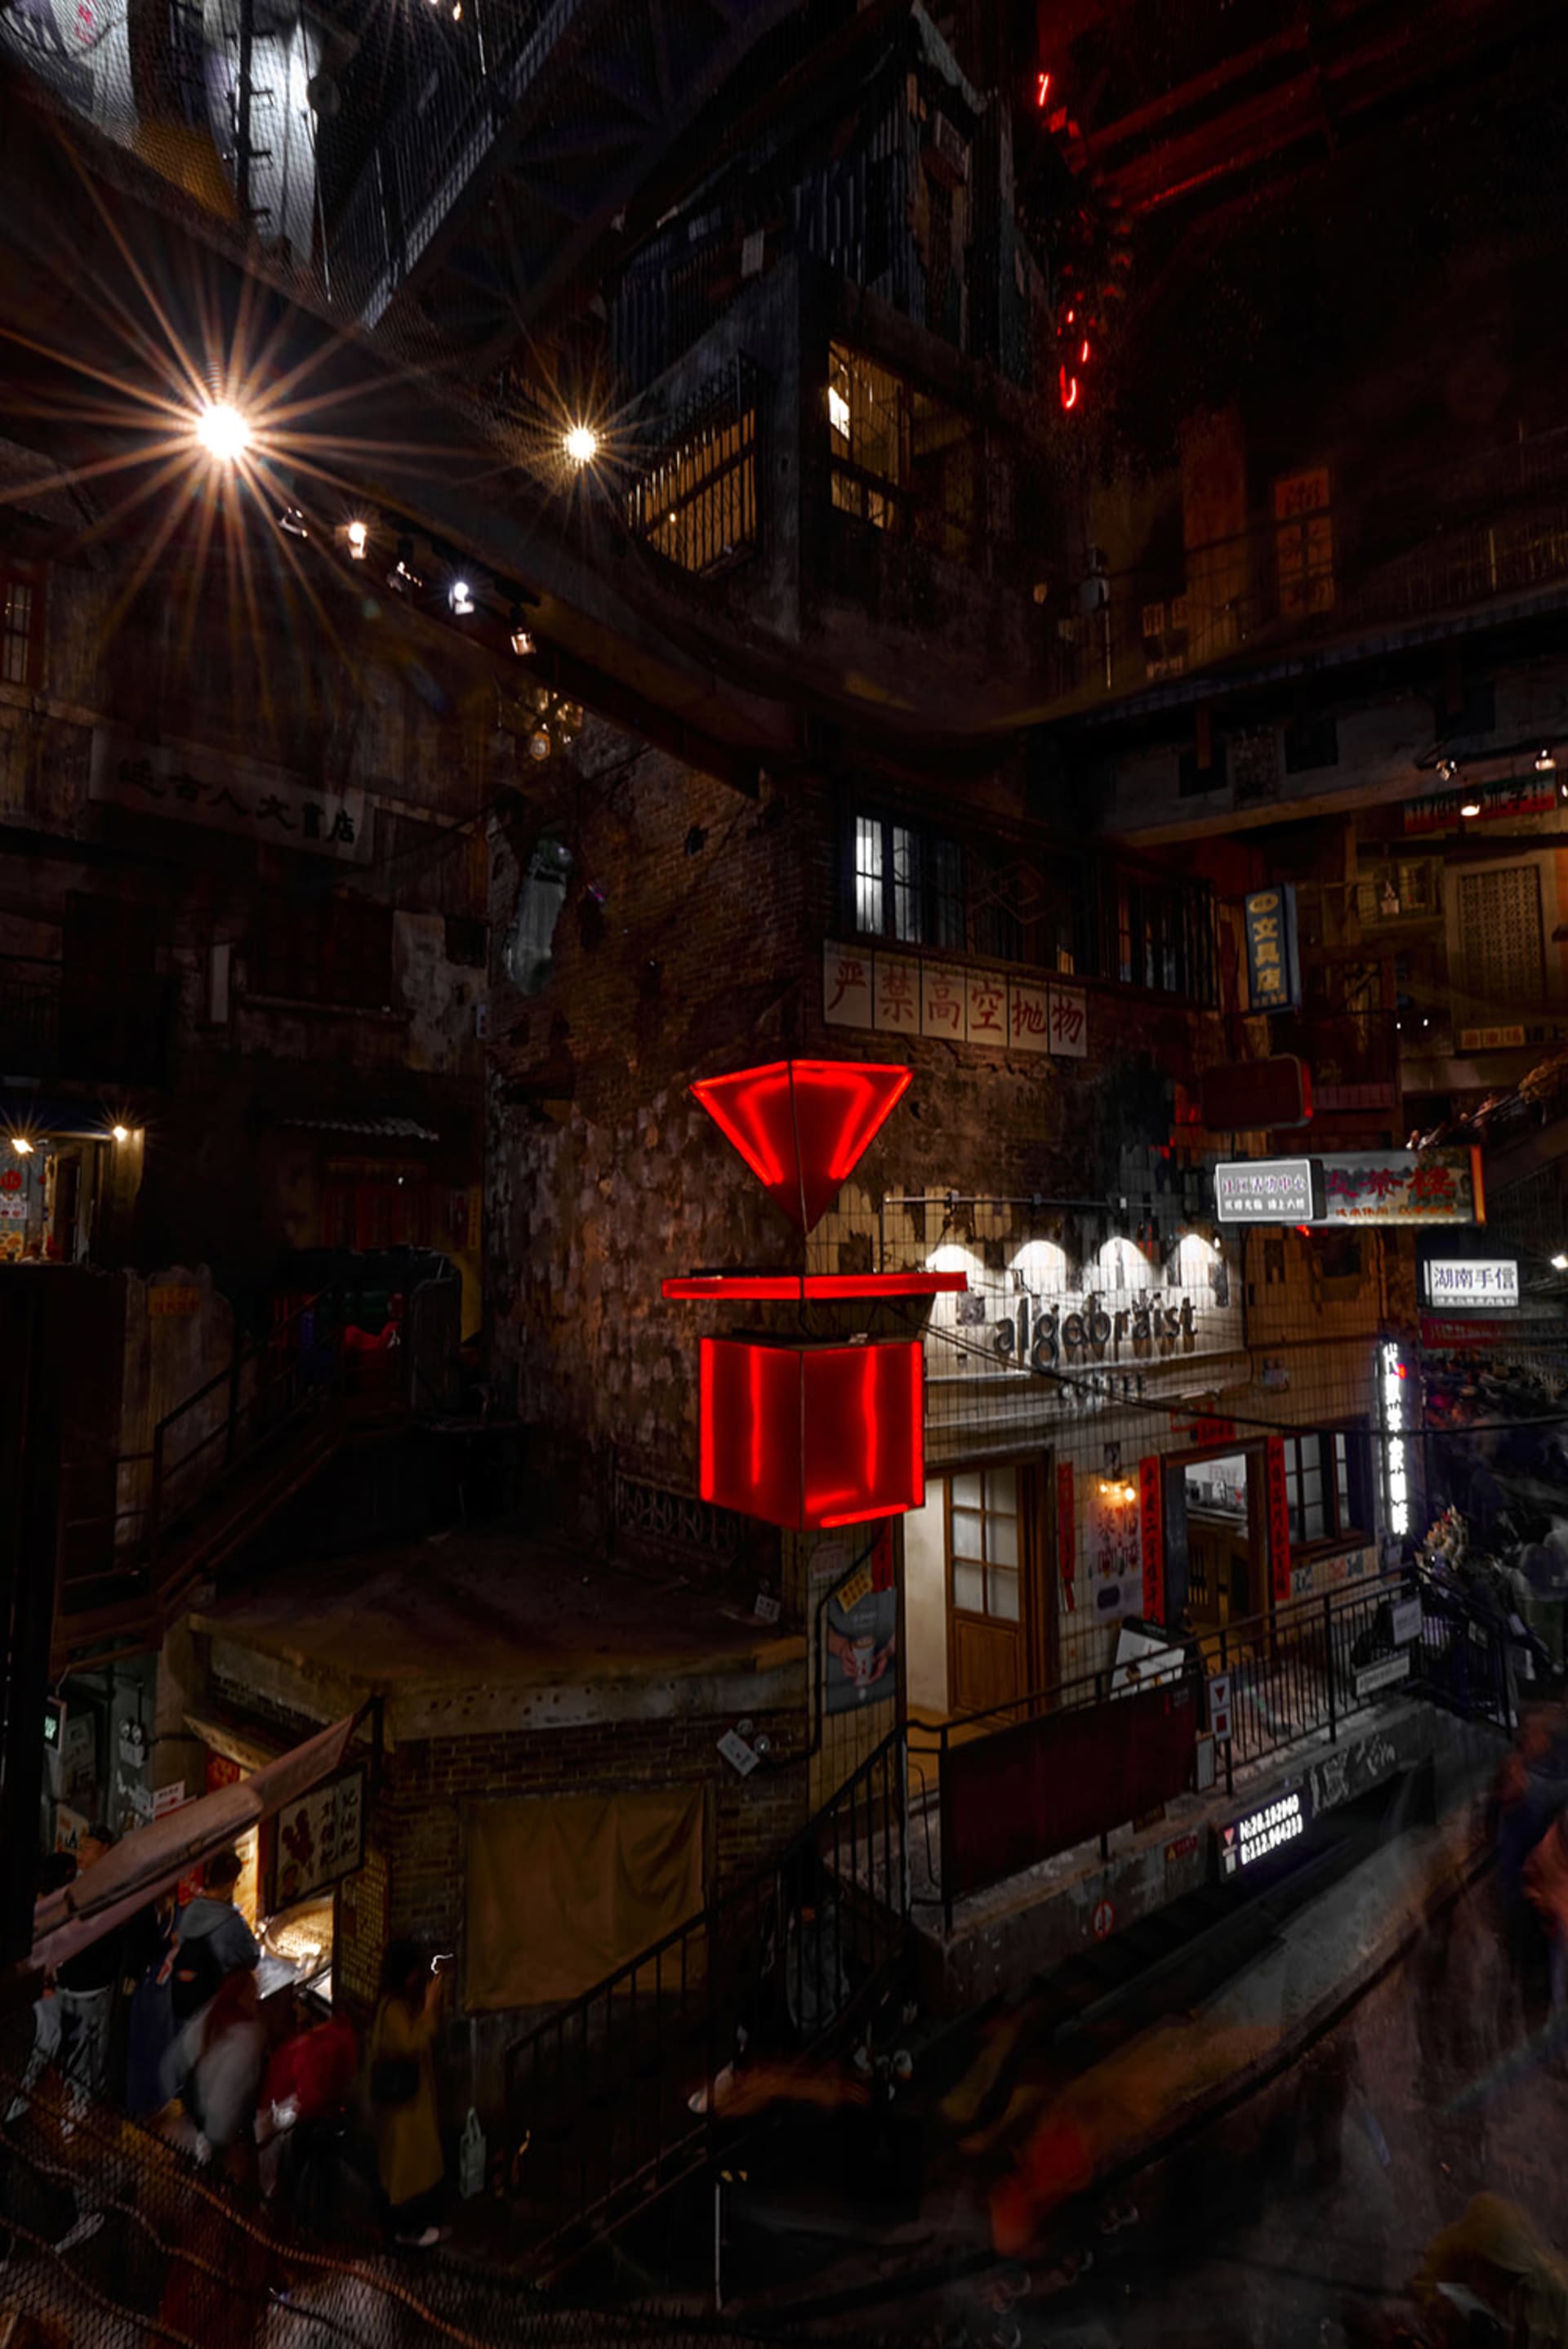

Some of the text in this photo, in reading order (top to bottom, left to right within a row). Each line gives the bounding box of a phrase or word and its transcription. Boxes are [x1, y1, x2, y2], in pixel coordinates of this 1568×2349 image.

[828, 961, 1083, 1045] 严禁高空抛物
[1435, 1267, 1515, 1290] 湖南手信
[993, 1295, 1199, 1370] algebraist
